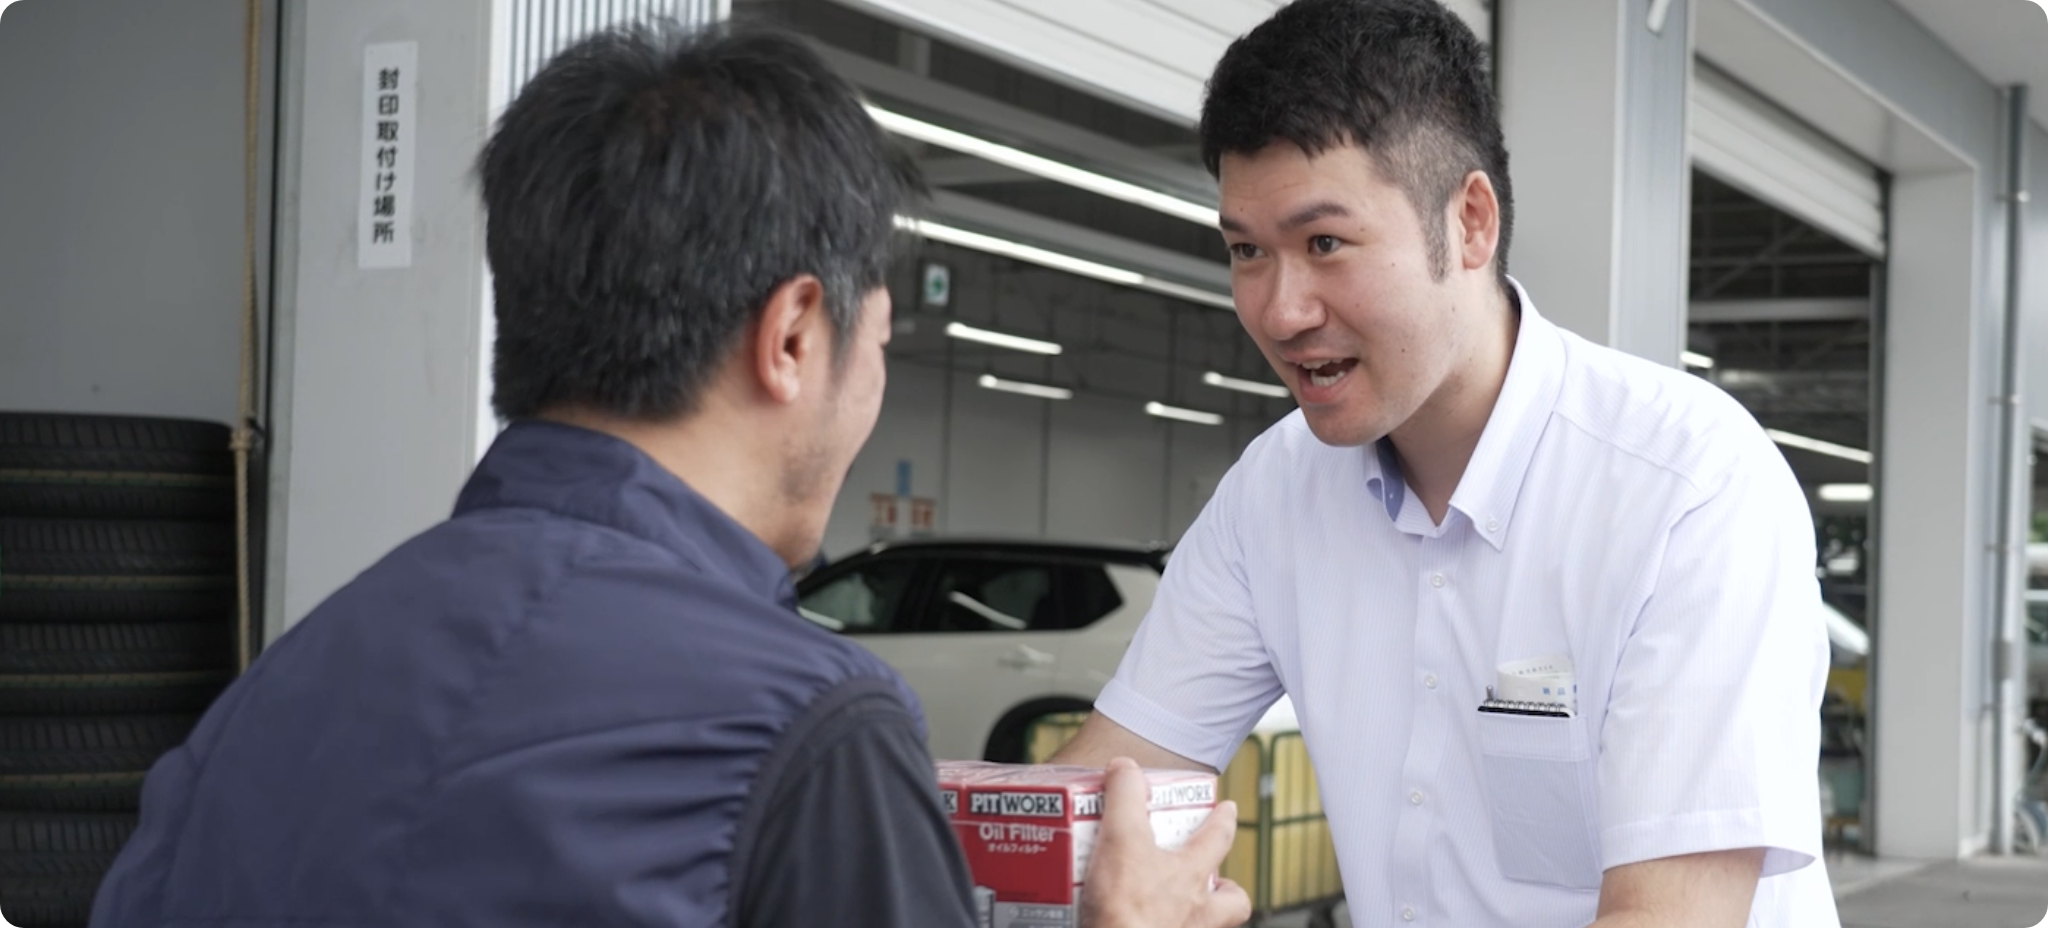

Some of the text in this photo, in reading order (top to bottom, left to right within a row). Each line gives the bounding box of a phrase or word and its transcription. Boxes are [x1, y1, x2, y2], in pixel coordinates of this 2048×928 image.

[373, 67, 400, 243] 封印取付け場所
[979, 822, 1055, 842] Oil Filter
